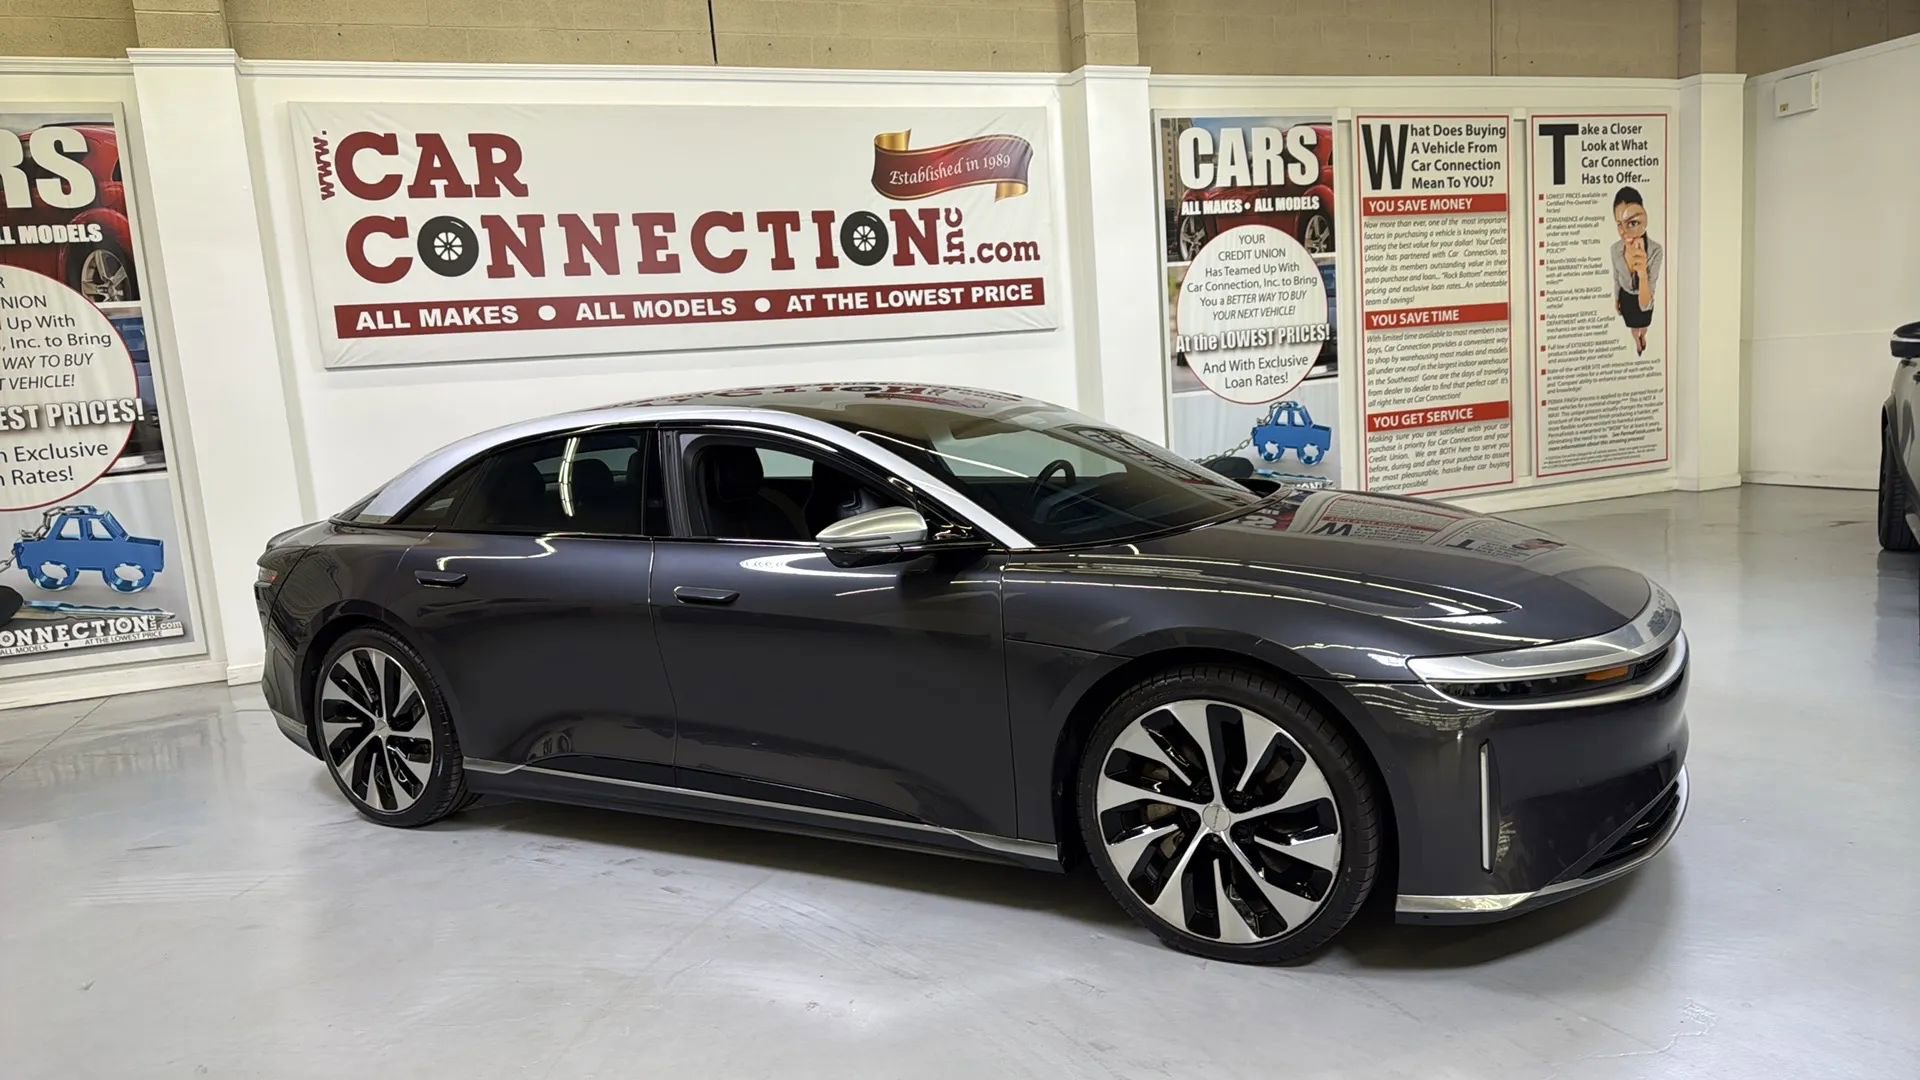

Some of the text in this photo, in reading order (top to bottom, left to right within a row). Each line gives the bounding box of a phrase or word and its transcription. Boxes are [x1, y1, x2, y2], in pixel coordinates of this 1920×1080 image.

[1433, 124, 1463, 136] Does
[1466, 123, 1506, 139] Buying
[1602, 126, 1608, 134] a
[1610, 122, 1642, 134] Closer
[1411, 141, 1497, 154] A Vehicle From
[1581, 140, 1648, 151] Look at What
[334, 131, 528, 200] CAR
[1179, 126, 1319, 189] CARS
[1411, 158, 1501, 171] Car Connection
[1581, 155, 1659, 168] Car Connection
[890, 154, 1010, 185] Established in 1989
[1412, 175, 1494, 189] Mean To YOU?
[1582, 172, 1650, 184] Has to Offer...
[1181, 199, 1242, 215] ALL MAKES
[1254, 196, 1320, 212] ALL MODELS
[1369, 198, 1472, 212] YOU SAVE MONEY
[18, 224, 103, 244] MODELS
[1239, 233, 1265, 244] YOUR
[346, 208, 940, 284] CONNECTION
[1218, 248, 1286, 261] CREDIT UNION
[1205, 262, 1300, 277] Has Teamed Up With
[1187, 276, 1317, 292] Car Connection, Inc. to Bring
[787, 284, 1033, 312] AT THE LOWEST PRICE
[1201, 297, 1217, 306] You
[1226, 294, 1257, 305] BETTER
[1258, 293, 1277, 302] WAY
[1278, 292, 1289, 301] TO
[1290, 291, 1307, 300] BUY
[576, 298, 737, 320] ALL MODELS
[1214, 305, 1296, 320] YOUR NEXT VEHICLE!
[7, 314, 75, 332] Up With
[356, 305, 519, 330] ALL MAKES
[1371, 309, 1459, 326] YOU SAVE TIME
[10, 334, 111, 349] Inc. to Bring
[1177, 324, 1330, 352] At the LOWEST PRICES!
[3, 353, 93, 370] WAY TO BUY
[1203, 356, 1308, 374] And With Exclusive
[10, 374, 75, 390] VEHICLE!
[1225, 372, 1288, 389] Loan Rates!
[45, 398, 145, 427] PRICES!
[1373, 408, 1473, 428] YOU GET SERVICE
[14, 444, 108, 462] Exclusive
[11, 466, 74, 485] Rates!
[96, 636, 108, 644] THE
[111, 634, 140, 642] LOWEST
[16, 645, 49, 653] MODELS
